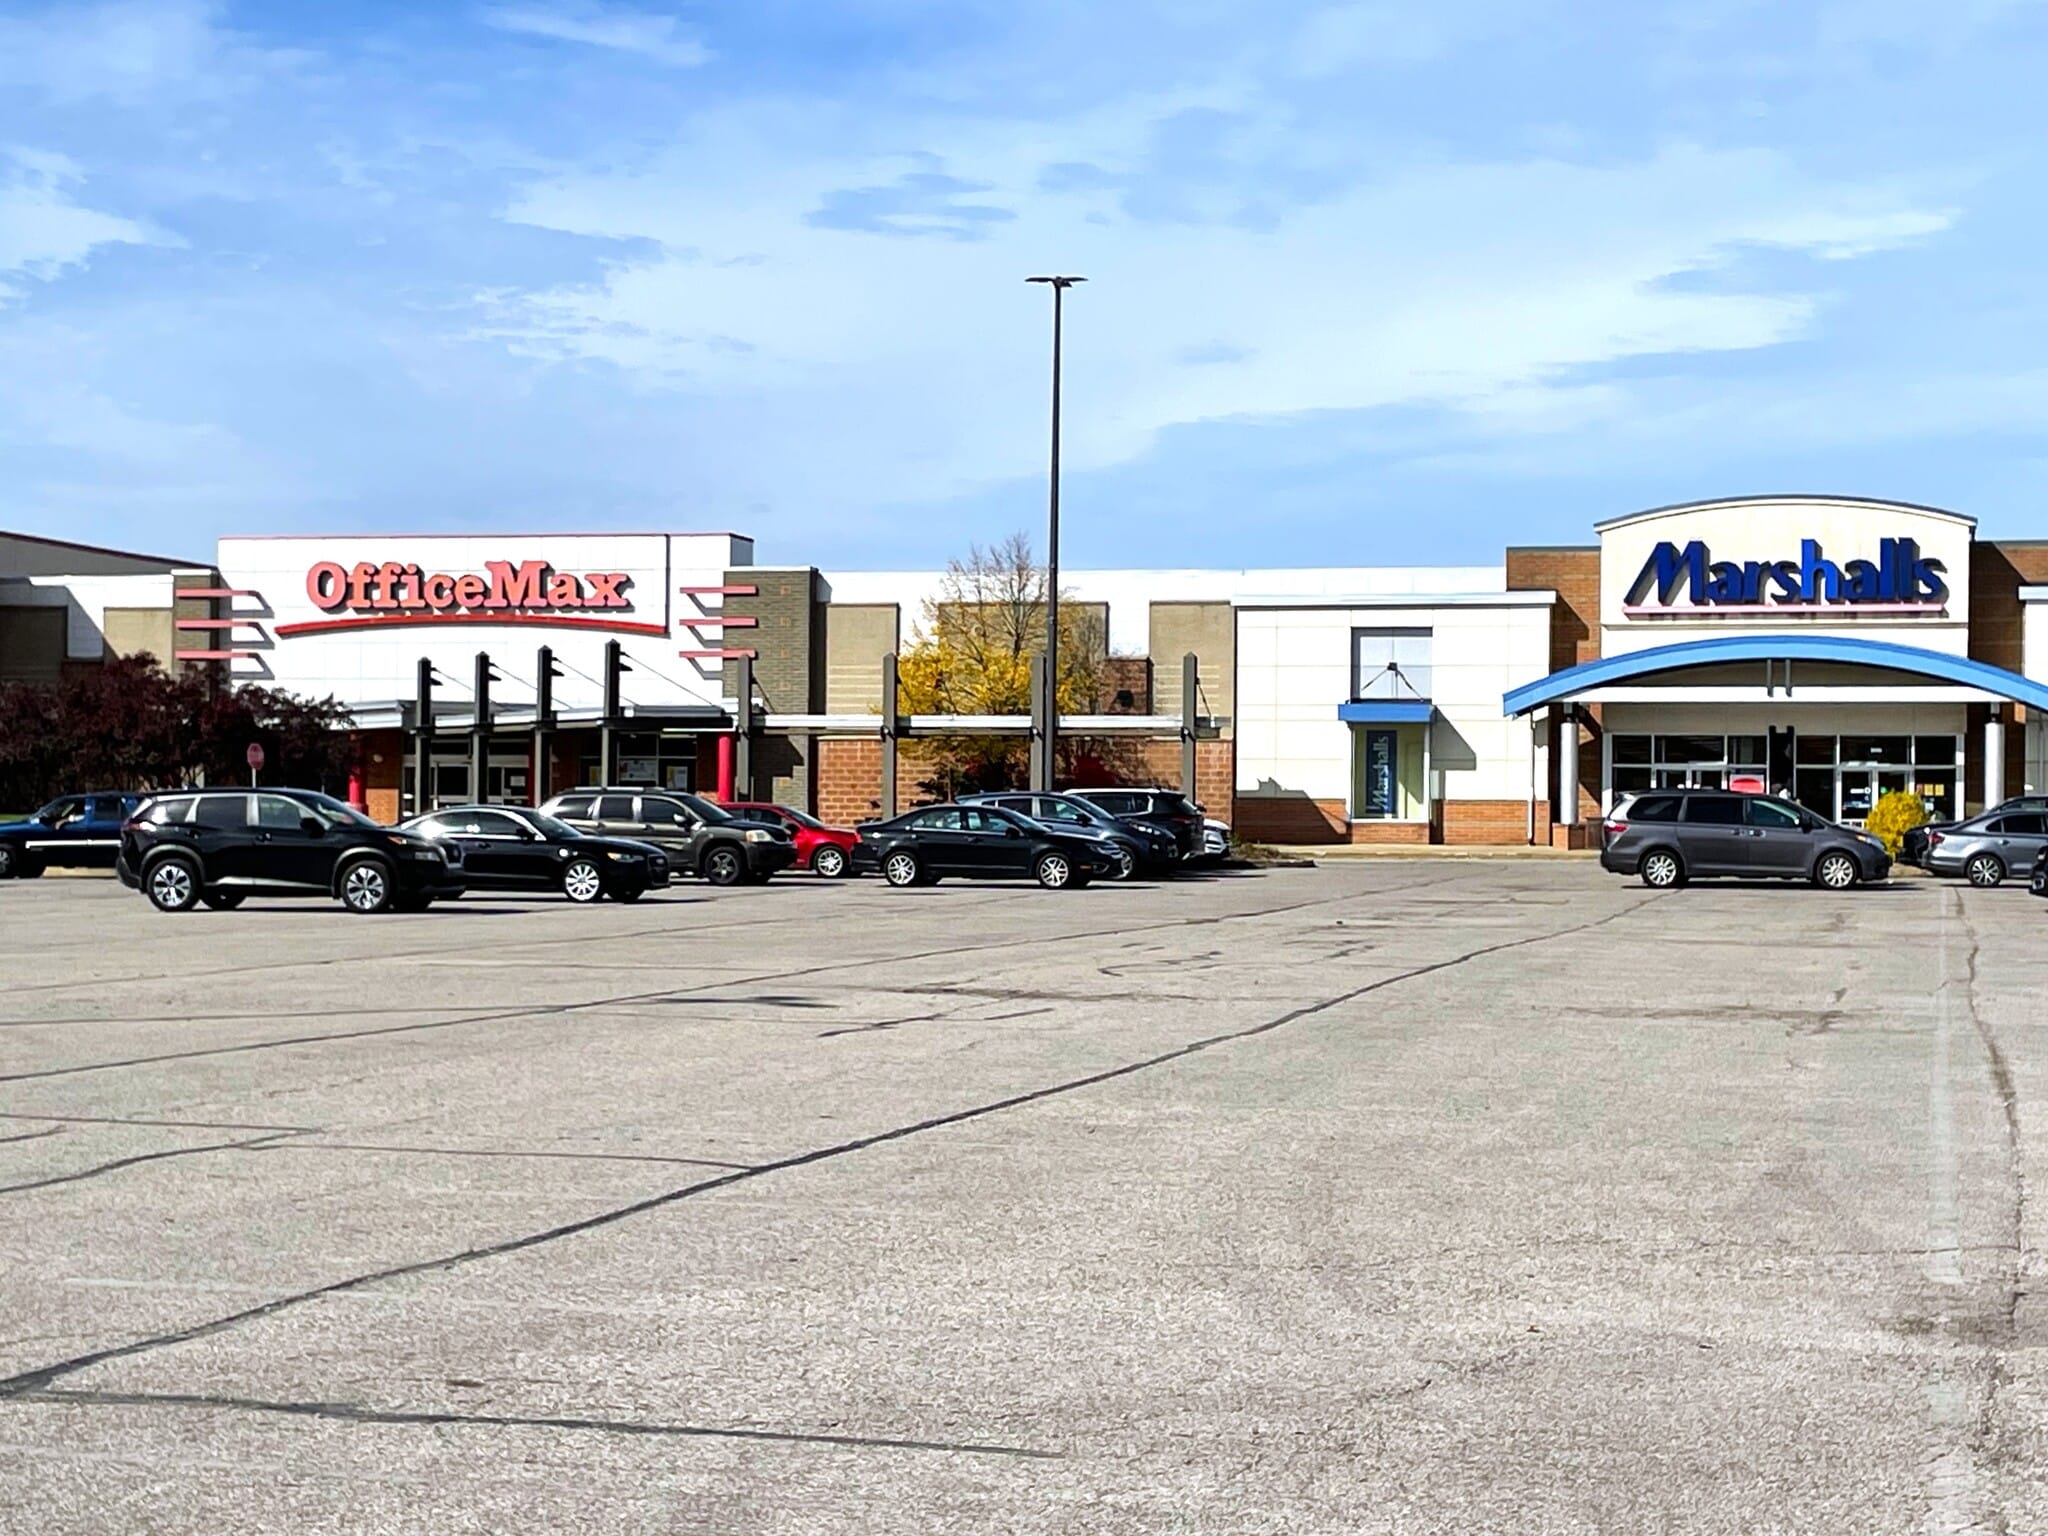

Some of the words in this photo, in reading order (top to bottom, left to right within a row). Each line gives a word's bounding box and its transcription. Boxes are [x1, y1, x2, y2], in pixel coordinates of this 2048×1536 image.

[306, 560, 633, 613] OfficeMax
[1624, 537, 1949, 606] Marshalls
[1372, 736, 1390, 811] Marshalls
